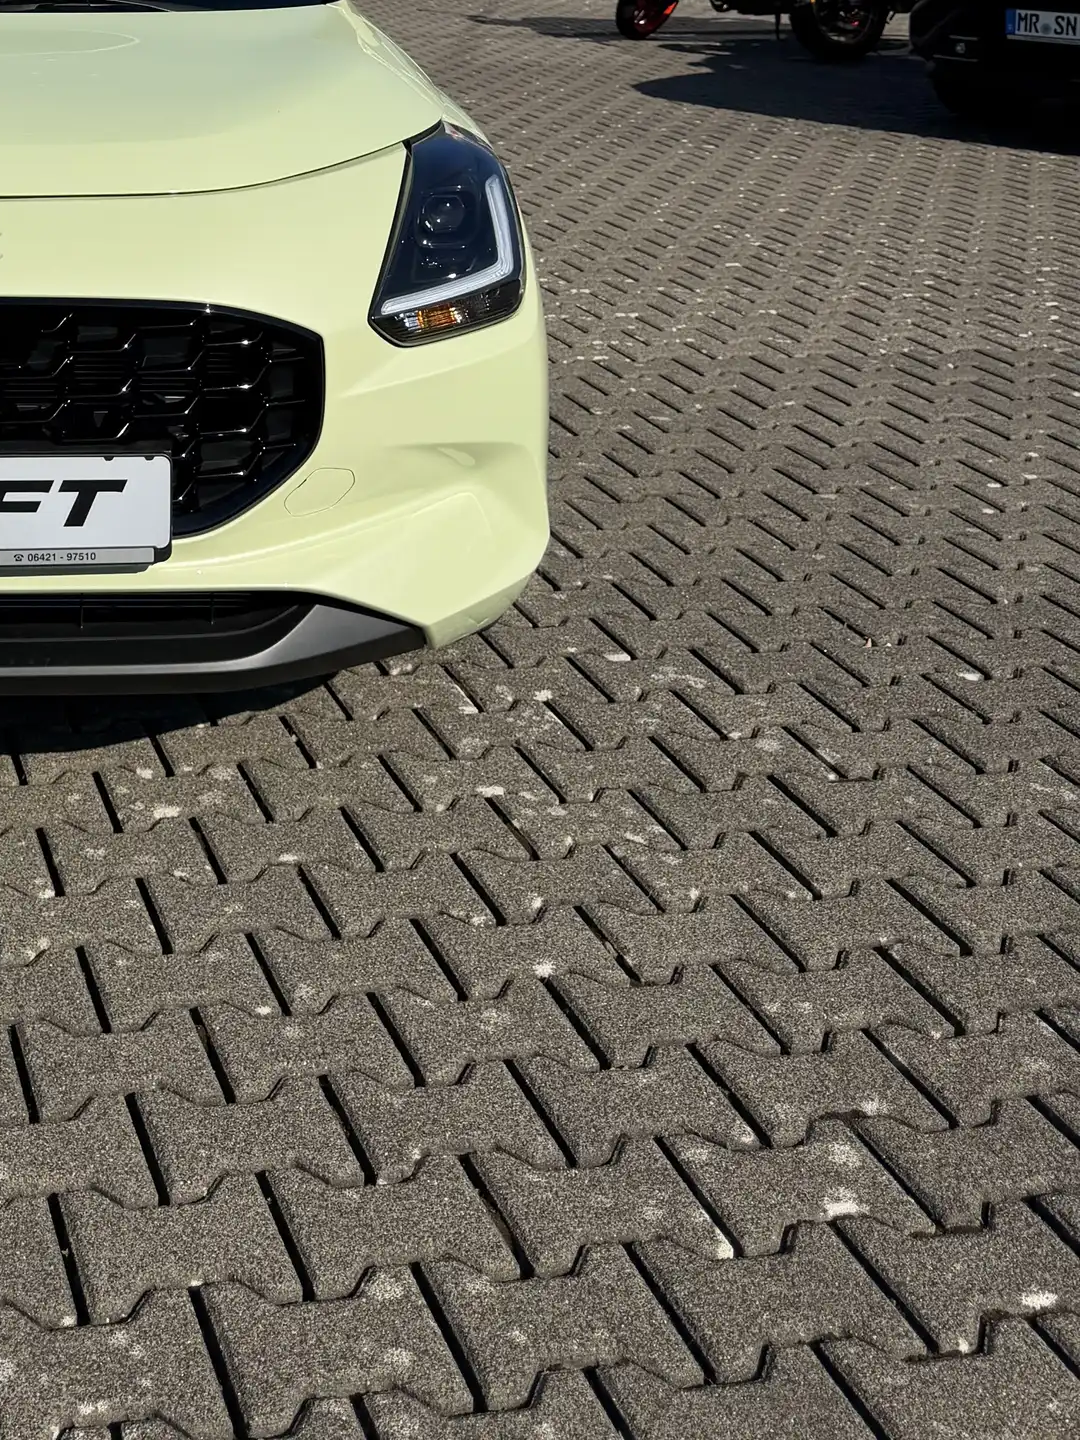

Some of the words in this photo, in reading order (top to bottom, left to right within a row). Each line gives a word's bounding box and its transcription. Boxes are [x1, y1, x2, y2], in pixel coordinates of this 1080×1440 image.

[1016, 12, 1040, 34] MR
[1053, 15, 1078, 37] SN
[27, 553, 57, 563] 06421
[66, 552, 97, 562] 97510
